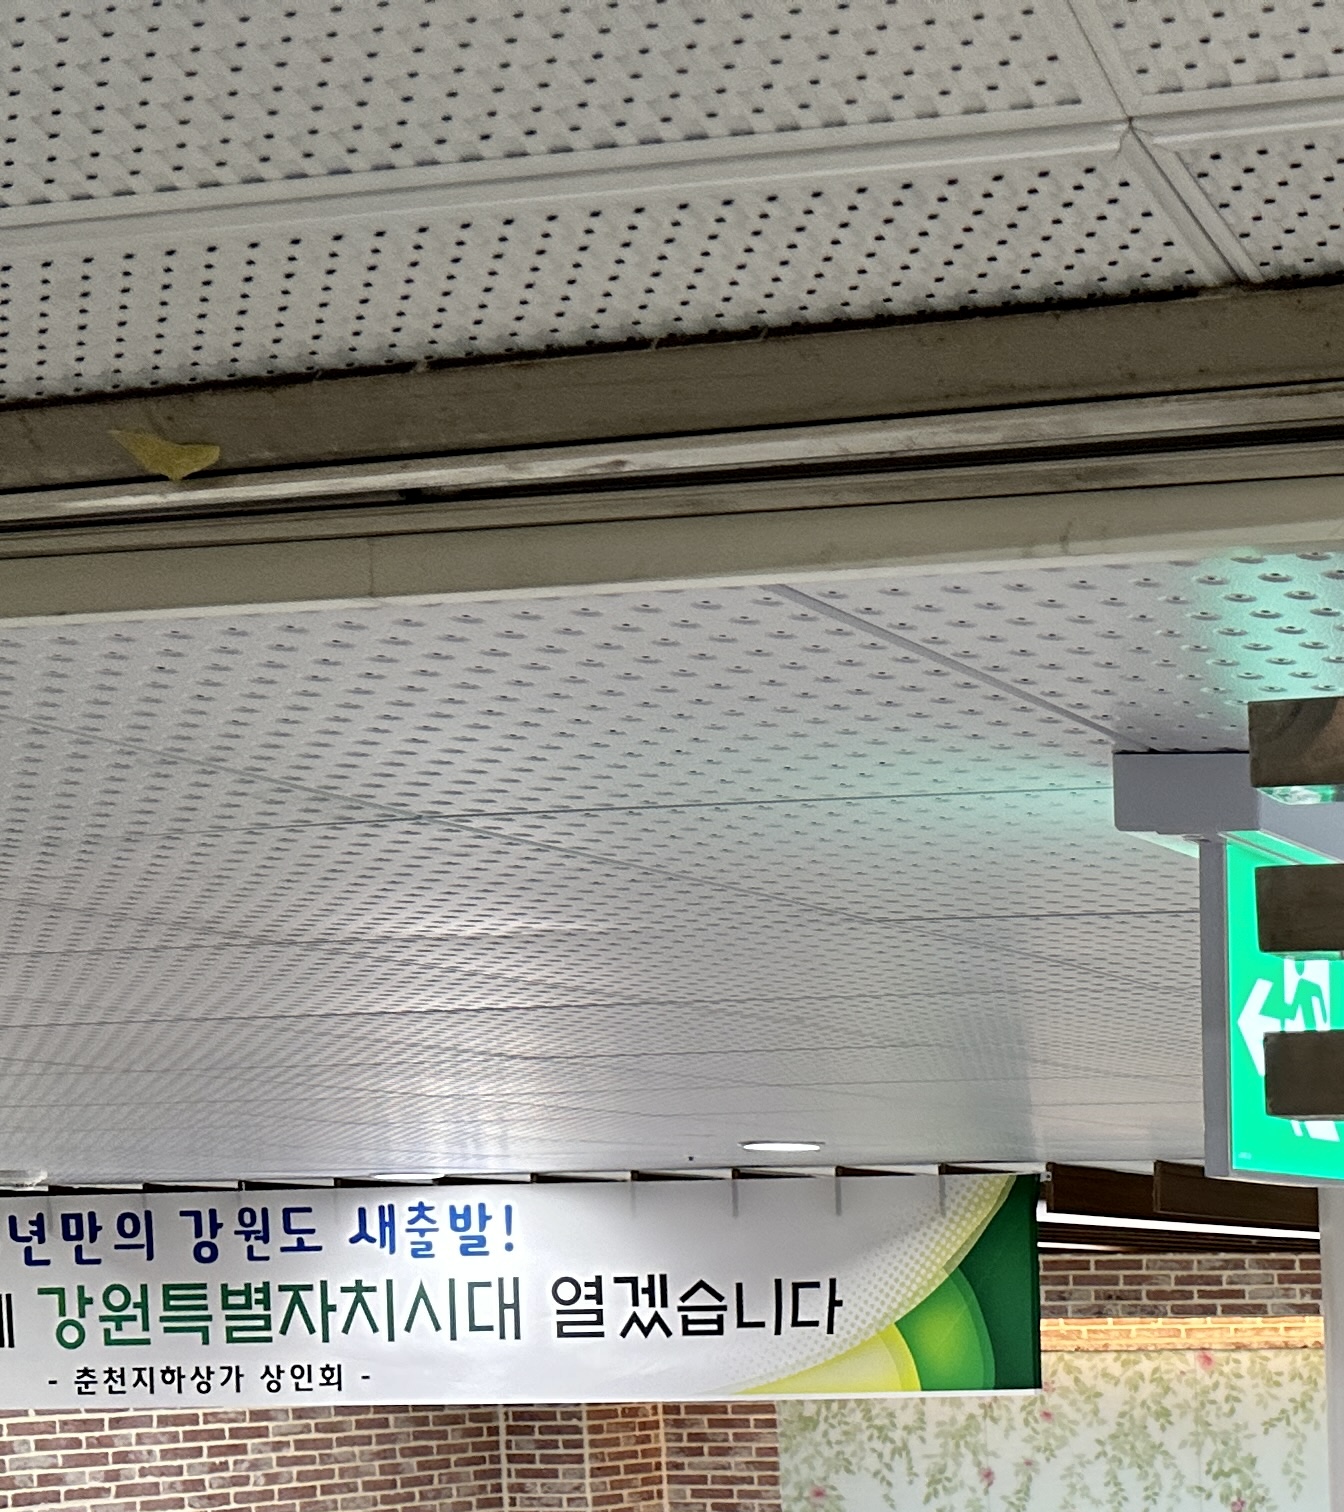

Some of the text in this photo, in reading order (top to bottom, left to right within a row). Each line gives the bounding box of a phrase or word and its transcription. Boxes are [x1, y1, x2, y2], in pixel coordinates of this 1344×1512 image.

[7, 1200, 515, 1267] 년만의 강원도 새출발!
[36, 1276, 522, 1350] 강원특별자치시대
[551, 1273, 845, 1340] 열겠습니다
[74, 1365, 245, 1396] 춘천지하상가
[260, 1363, 343, 1394] 상인회
